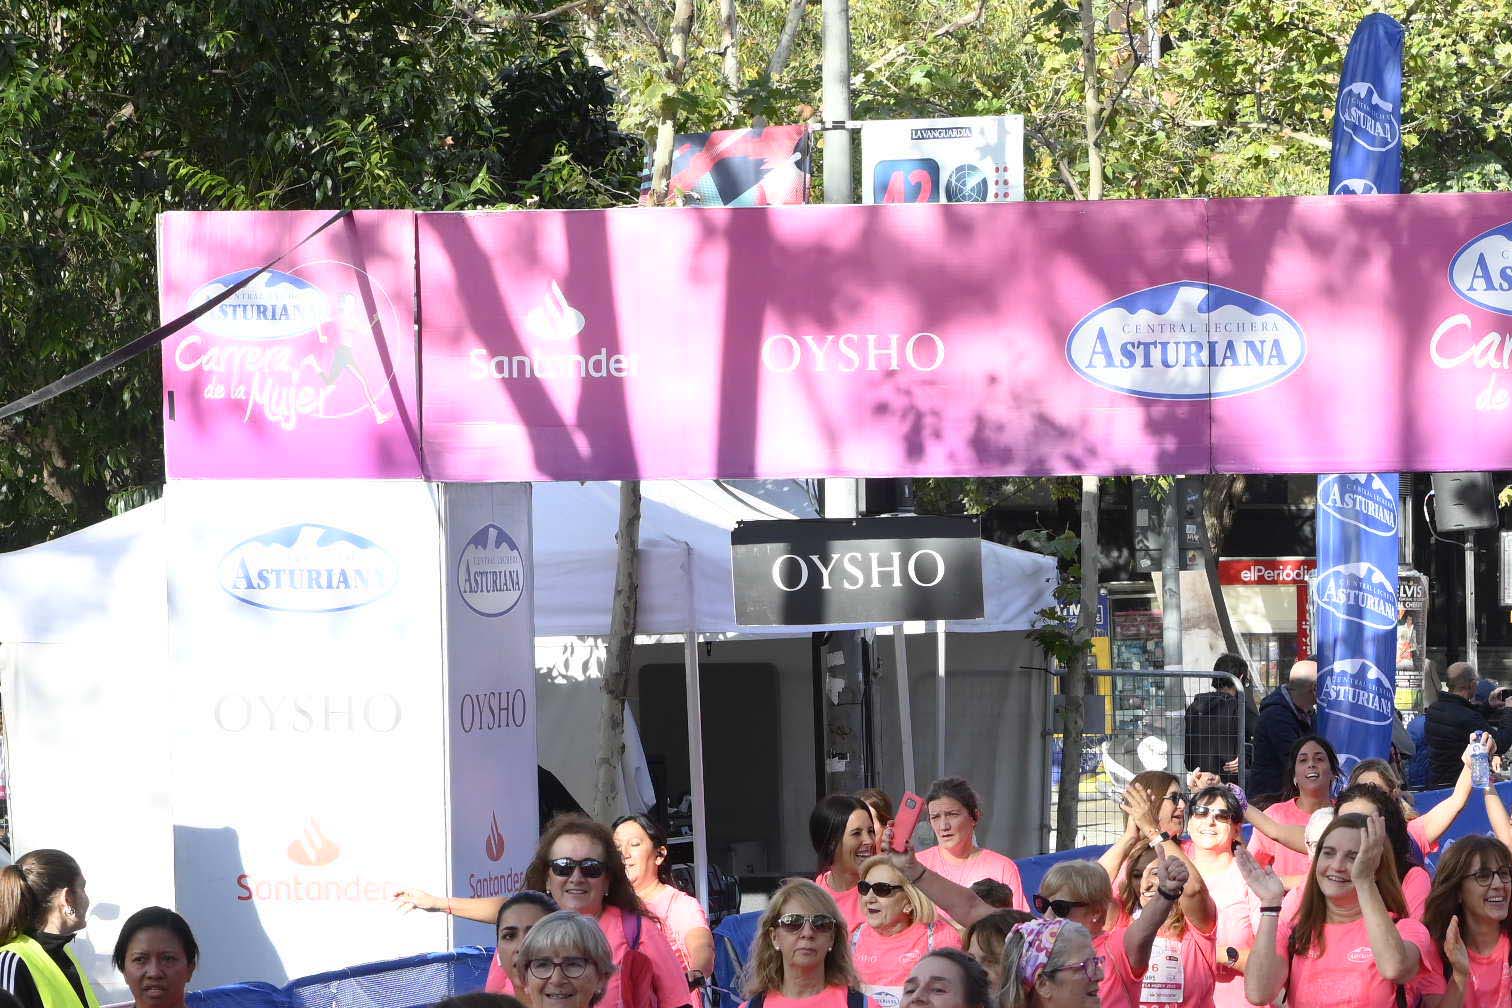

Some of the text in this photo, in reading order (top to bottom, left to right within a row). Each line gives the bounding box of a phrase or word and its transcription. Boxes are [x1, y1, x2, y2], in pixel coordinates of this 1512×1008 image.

[923, 127, 972, 139] VANGUARDIA
[1122, 320, 1280, 334] CENTRAL LECHERA
[175, 335, 293, 373] Carrera
[469, 348, 639, 380] Santander
[761, 332, 946, 374] OYSHO
[1085, 325, 1288, 372] ASTURIANA
[1476, 372, 1510, 411] de
[1327, 483, 1395, 528] ASTURIANA
[463, 558, 521, 594] ASTURIANA
[772, 549, 945, 592] OYSHO
[1324, 577, 1395, 620] ASTURIANA
[214, 692, 403, 734] OYSHO
[460, 688, 527, 733] OYSHO
[1322, 676, 1393, 716] ASTURIANA
[237, 873, 395, 902] Santander
